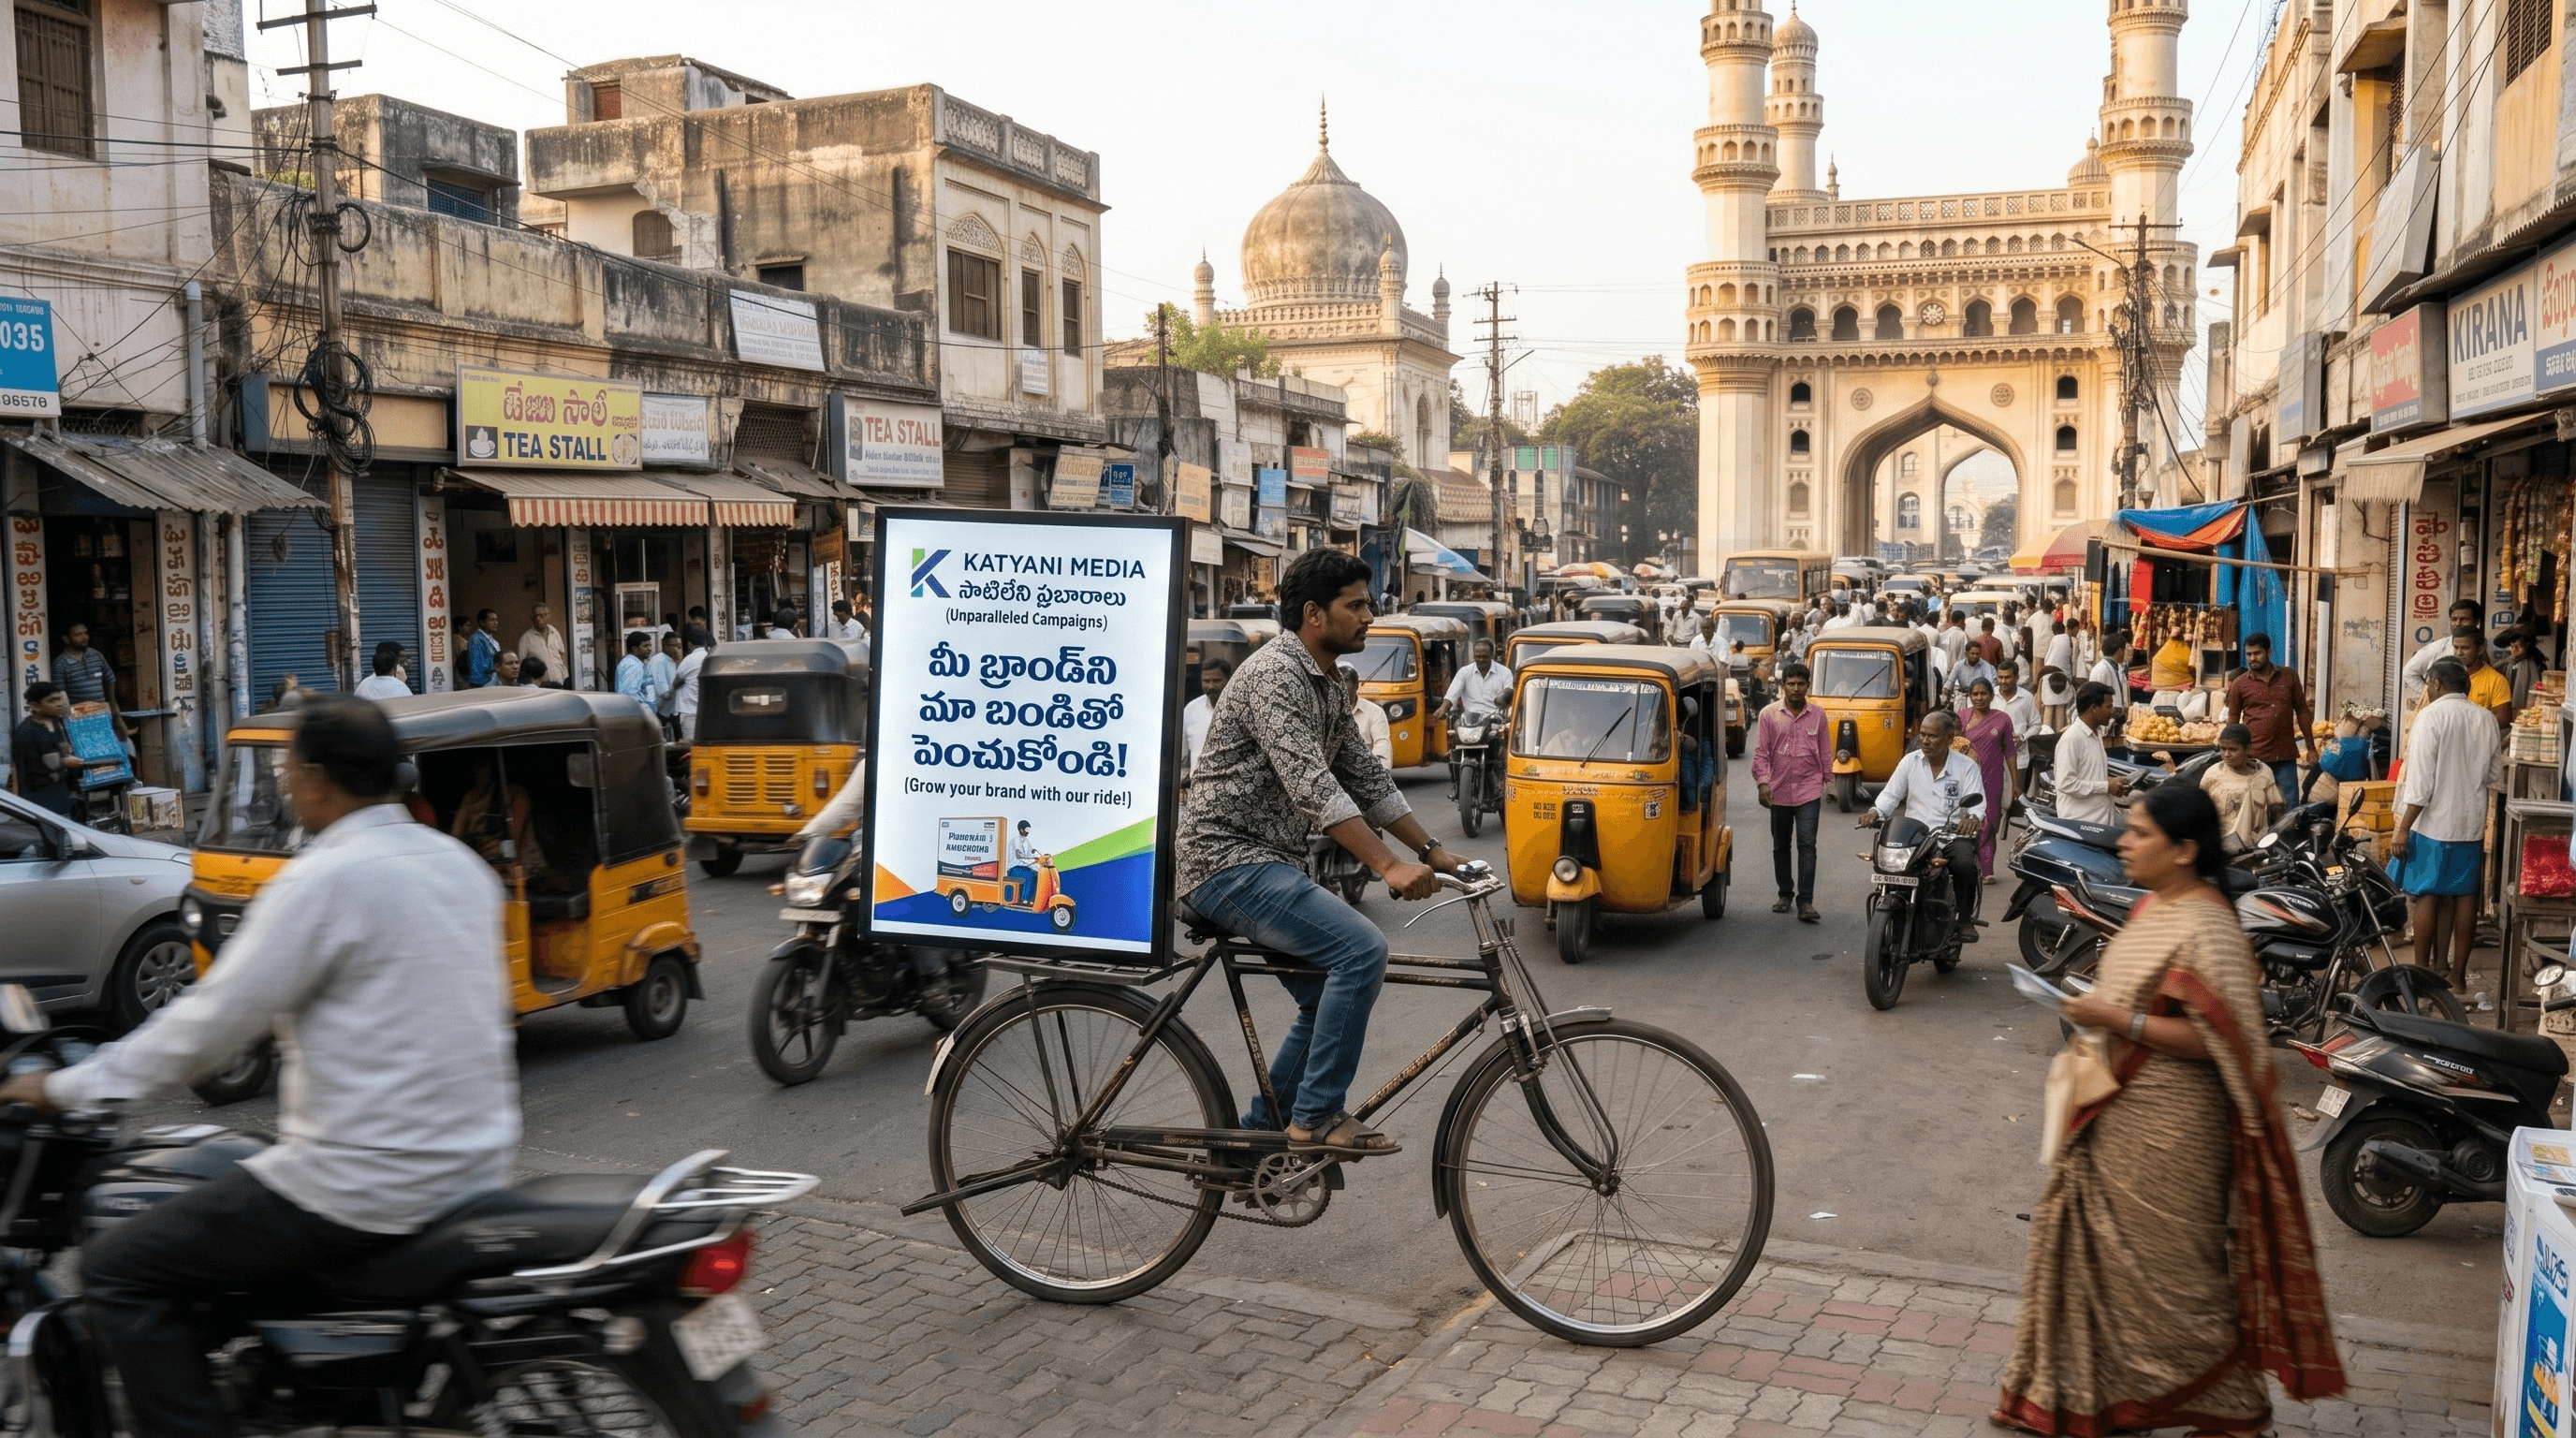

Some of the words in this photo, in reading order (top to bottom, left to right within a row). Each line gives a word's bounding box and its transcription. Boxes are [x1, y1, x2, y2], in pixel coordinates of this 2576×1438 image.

[2453, 283, 2528, 365] KIRANA
[504, 432, 544, 459] TEA
[549, 433, 607, 462] STALL
[865, 416, 894, 444] TEA
[898, 418, 941, 448] STALL
[964, 552, 1062, 576] KATYANI
[1070, 557, 1146, 580] MEDIA
[959, 578, 1032, 602] సాటిలేని
[945, 607, 1029, 626] (Unparalleled
[1032, 612, 1108, 633] Campaigns)
[929, 640, 971, 678] మీ
[919, 690, 976, 723] మా
[985, 693, 1124, 730] బండితో
[911, 734, 1128, 778] పెంచుకోండి!
[904, 776, 946, 795] (Grow
[949, 783, 982, 799] your
[985, 782, 1027, 800] brand
[1030, 785, 1061, 802] with
[1065, 790, 1090, 803] our
[1093, 789, 1132, 810] ride!)
